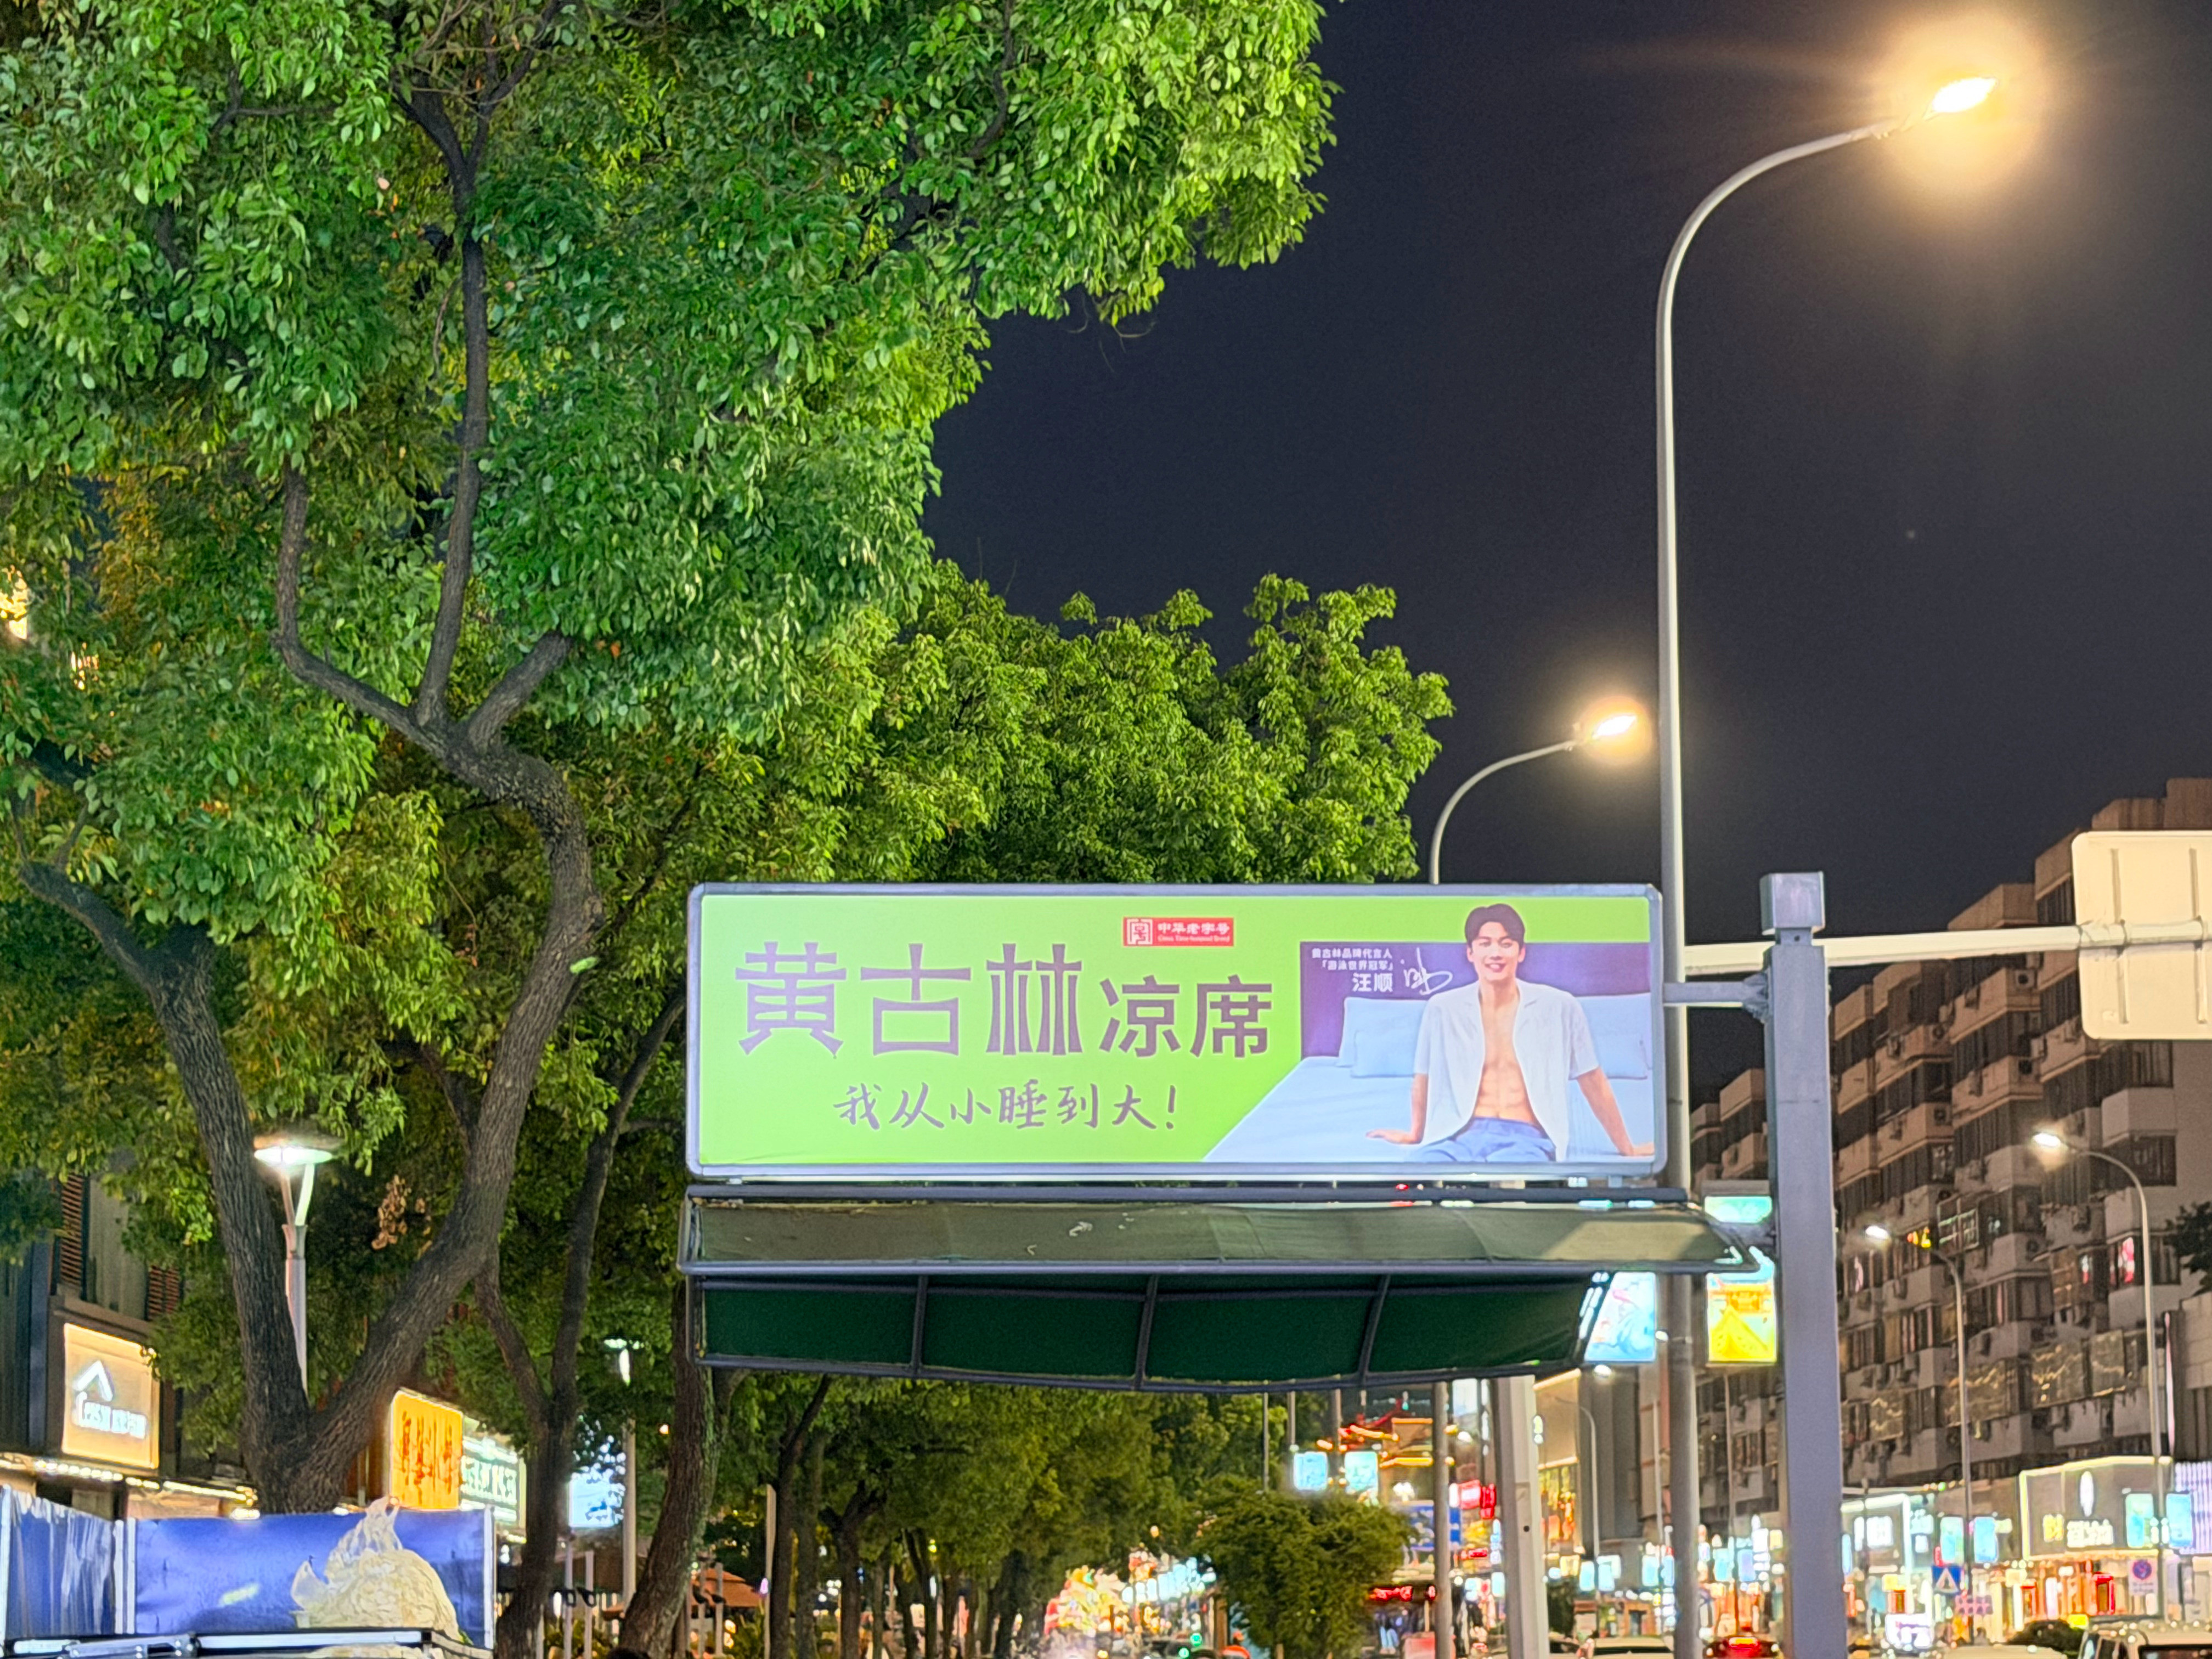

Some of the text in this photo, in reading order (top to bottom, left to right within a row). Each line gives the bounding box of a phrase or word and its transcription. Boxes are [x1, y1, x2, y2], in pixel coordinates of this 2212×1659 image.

[735, 941, 1272, 1058] 黄古林凉席
[1352, 972, 1393, 992] 汪顺
